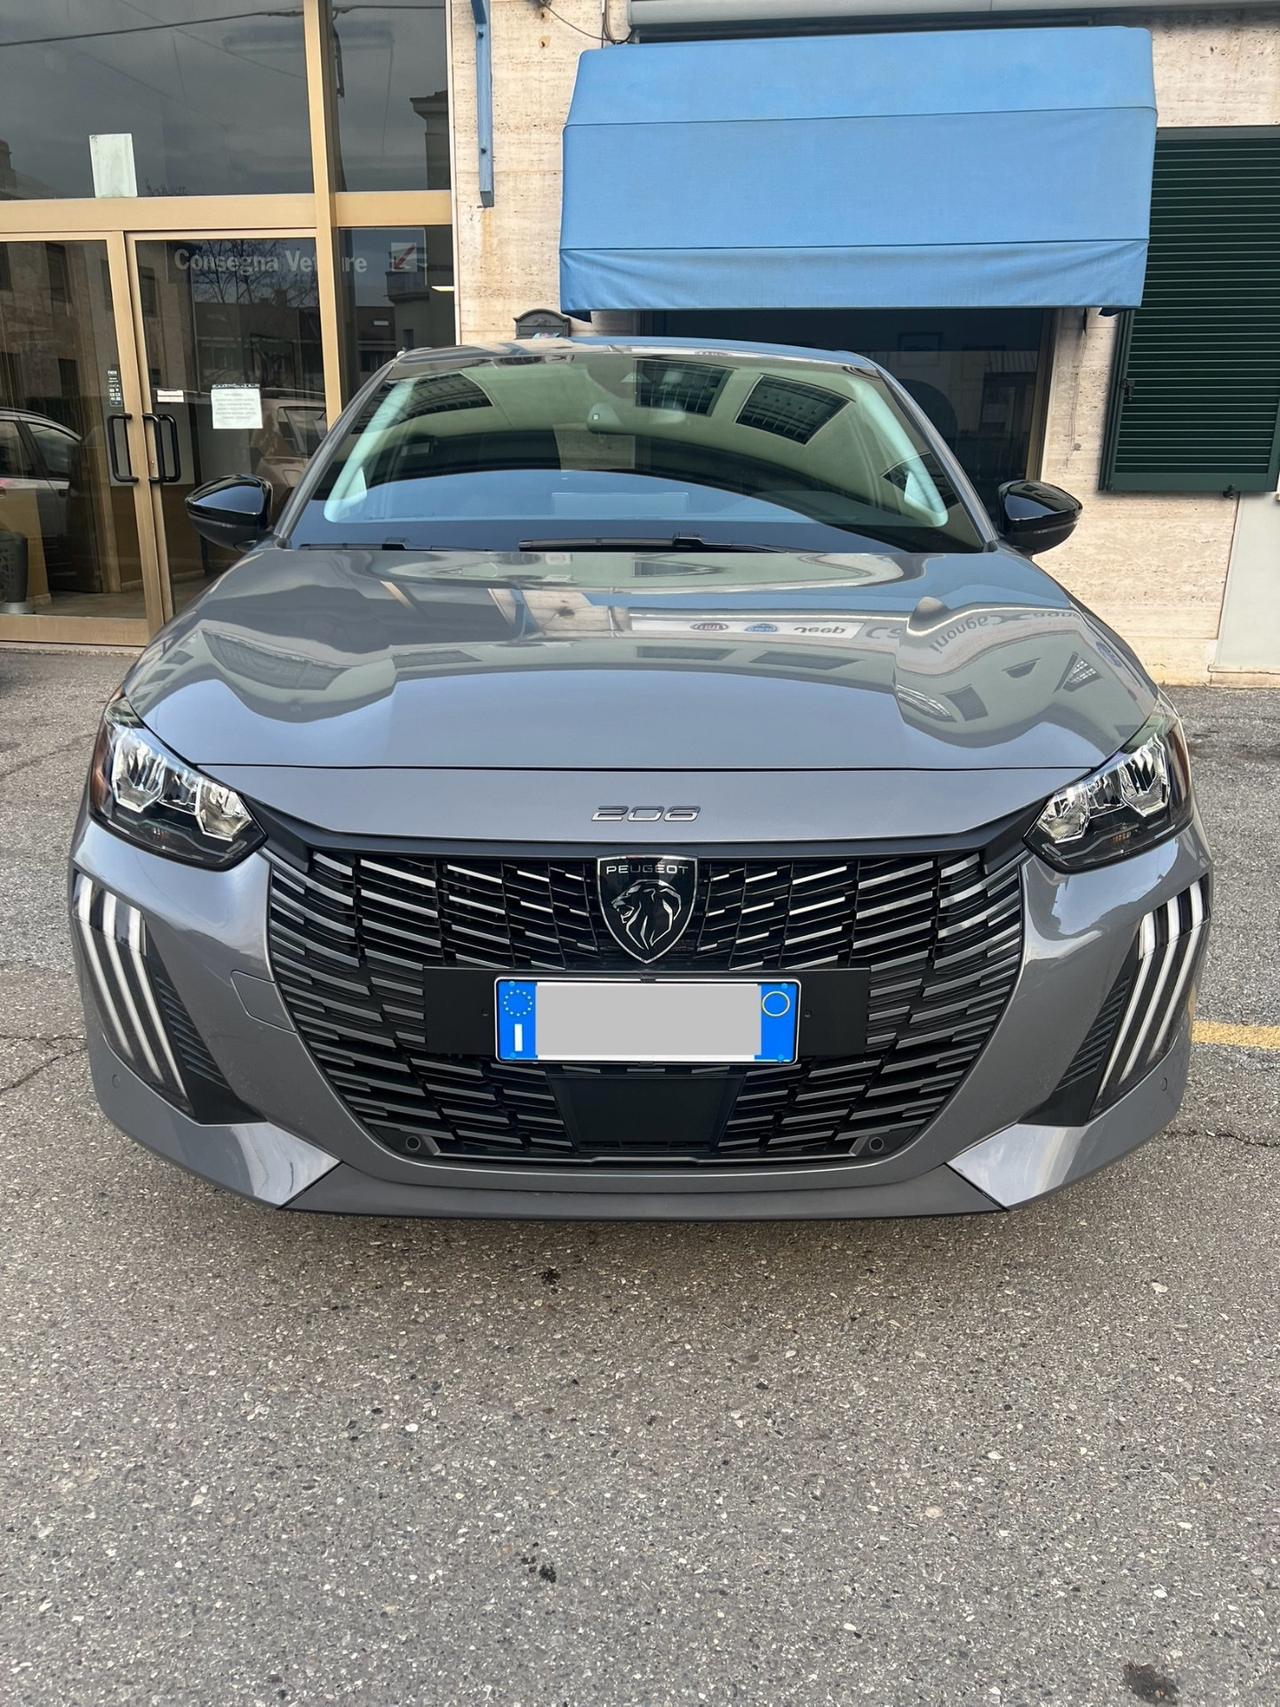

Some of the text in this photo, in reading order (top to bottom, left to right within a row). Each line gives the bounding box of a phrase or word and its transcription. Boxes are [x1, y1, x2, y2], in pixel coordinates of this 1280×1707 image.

[175, 248, 368, 275] Consegna Vetre
[591, 805, 702, 822] 208
[606, 864, 689, 875] PEUGEOT
